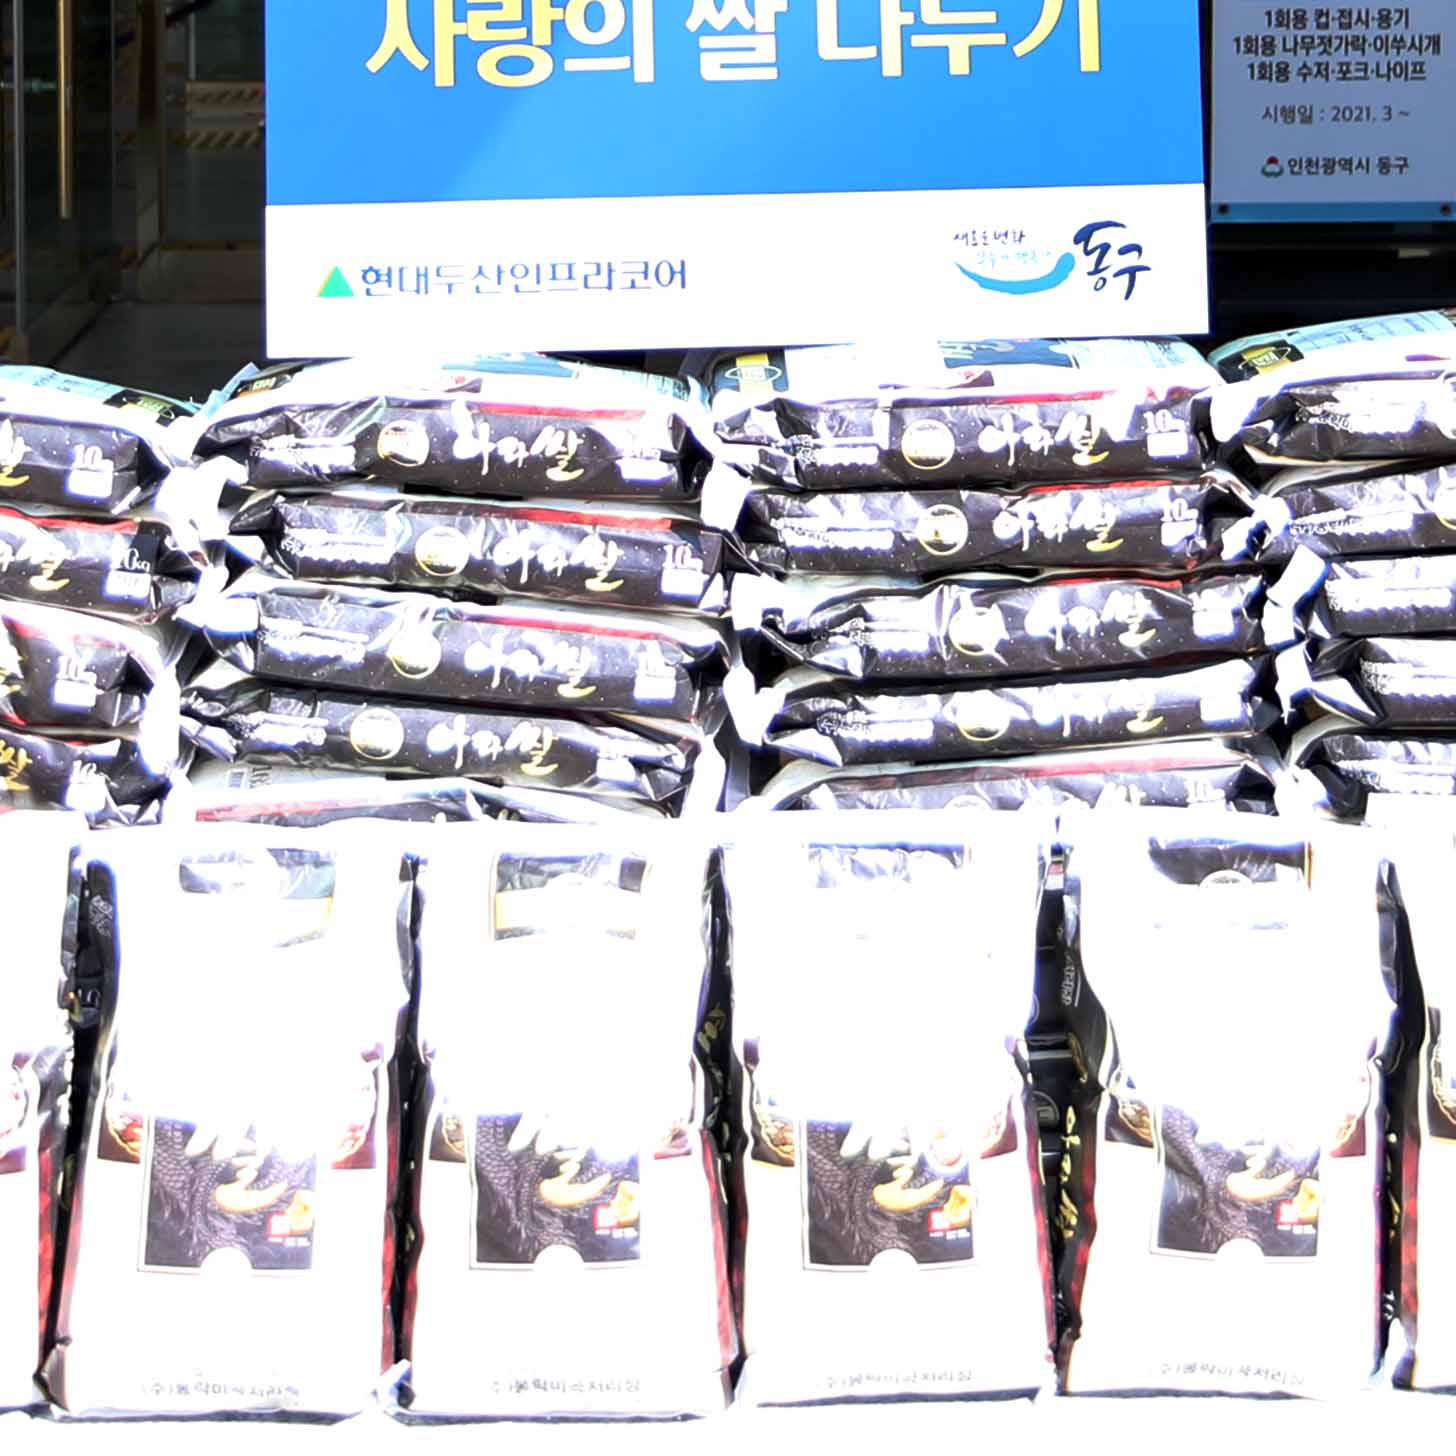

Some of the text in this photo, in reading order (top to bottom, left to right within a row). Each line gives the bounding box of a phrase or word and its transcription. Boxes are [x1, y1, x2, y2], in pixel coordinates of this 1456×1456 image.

[1264, 8, 1410, 30] 1회용 컵·접시·용기
[1233, 34, 1277, 56] 1회용
[1247, 61, 1291, 82] 1회용
[1261, 104, 1314, 125] 시행일
[1287, 156, 1410, 177] 인천광역시 동구
[1073, 220, 1152, 301] 동구
[359, 259, 688, 299] 현대두산인프라코어
